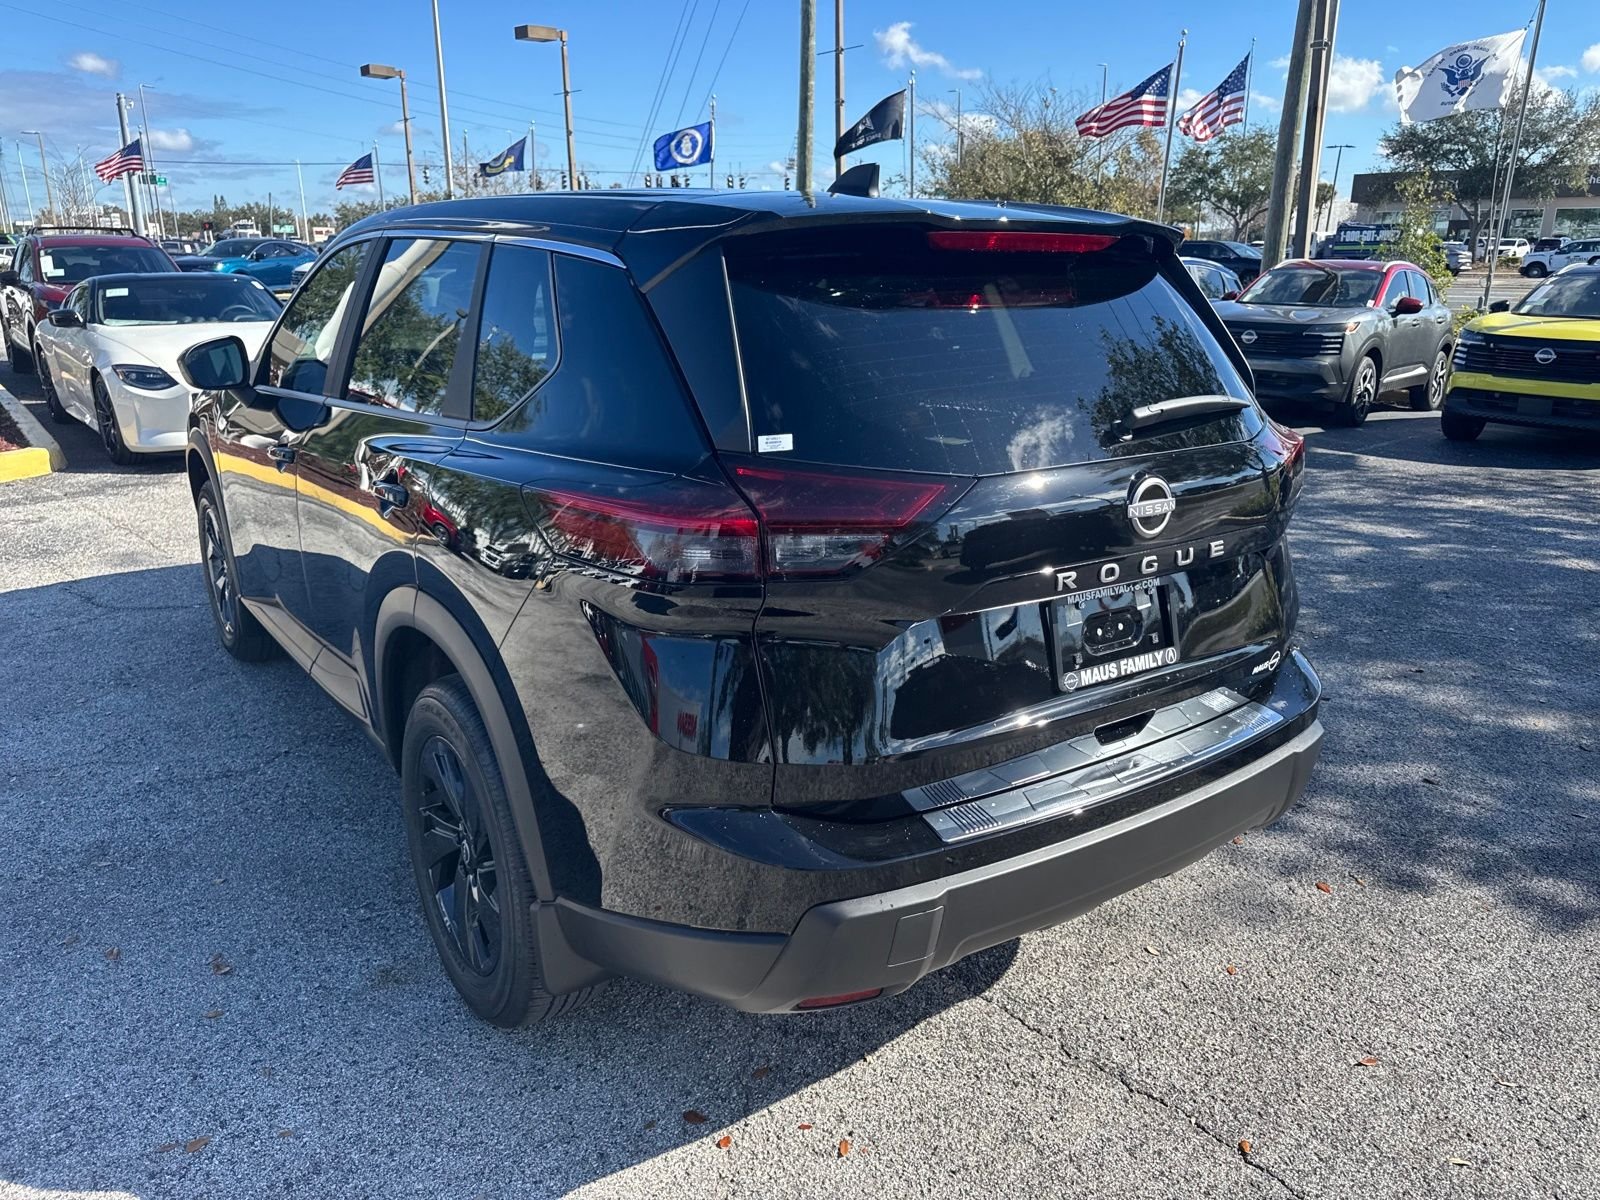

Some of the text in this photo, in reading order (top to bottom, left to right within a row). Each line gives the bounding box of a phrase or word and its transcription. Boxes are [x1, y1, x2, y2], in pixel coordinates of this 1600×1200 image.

[1129, 500, 1176, 518] NISSAN
[1056, 540, 1225, 591] ROGUE
[1080, 649, 1163, 686] MAUS FAMILY
